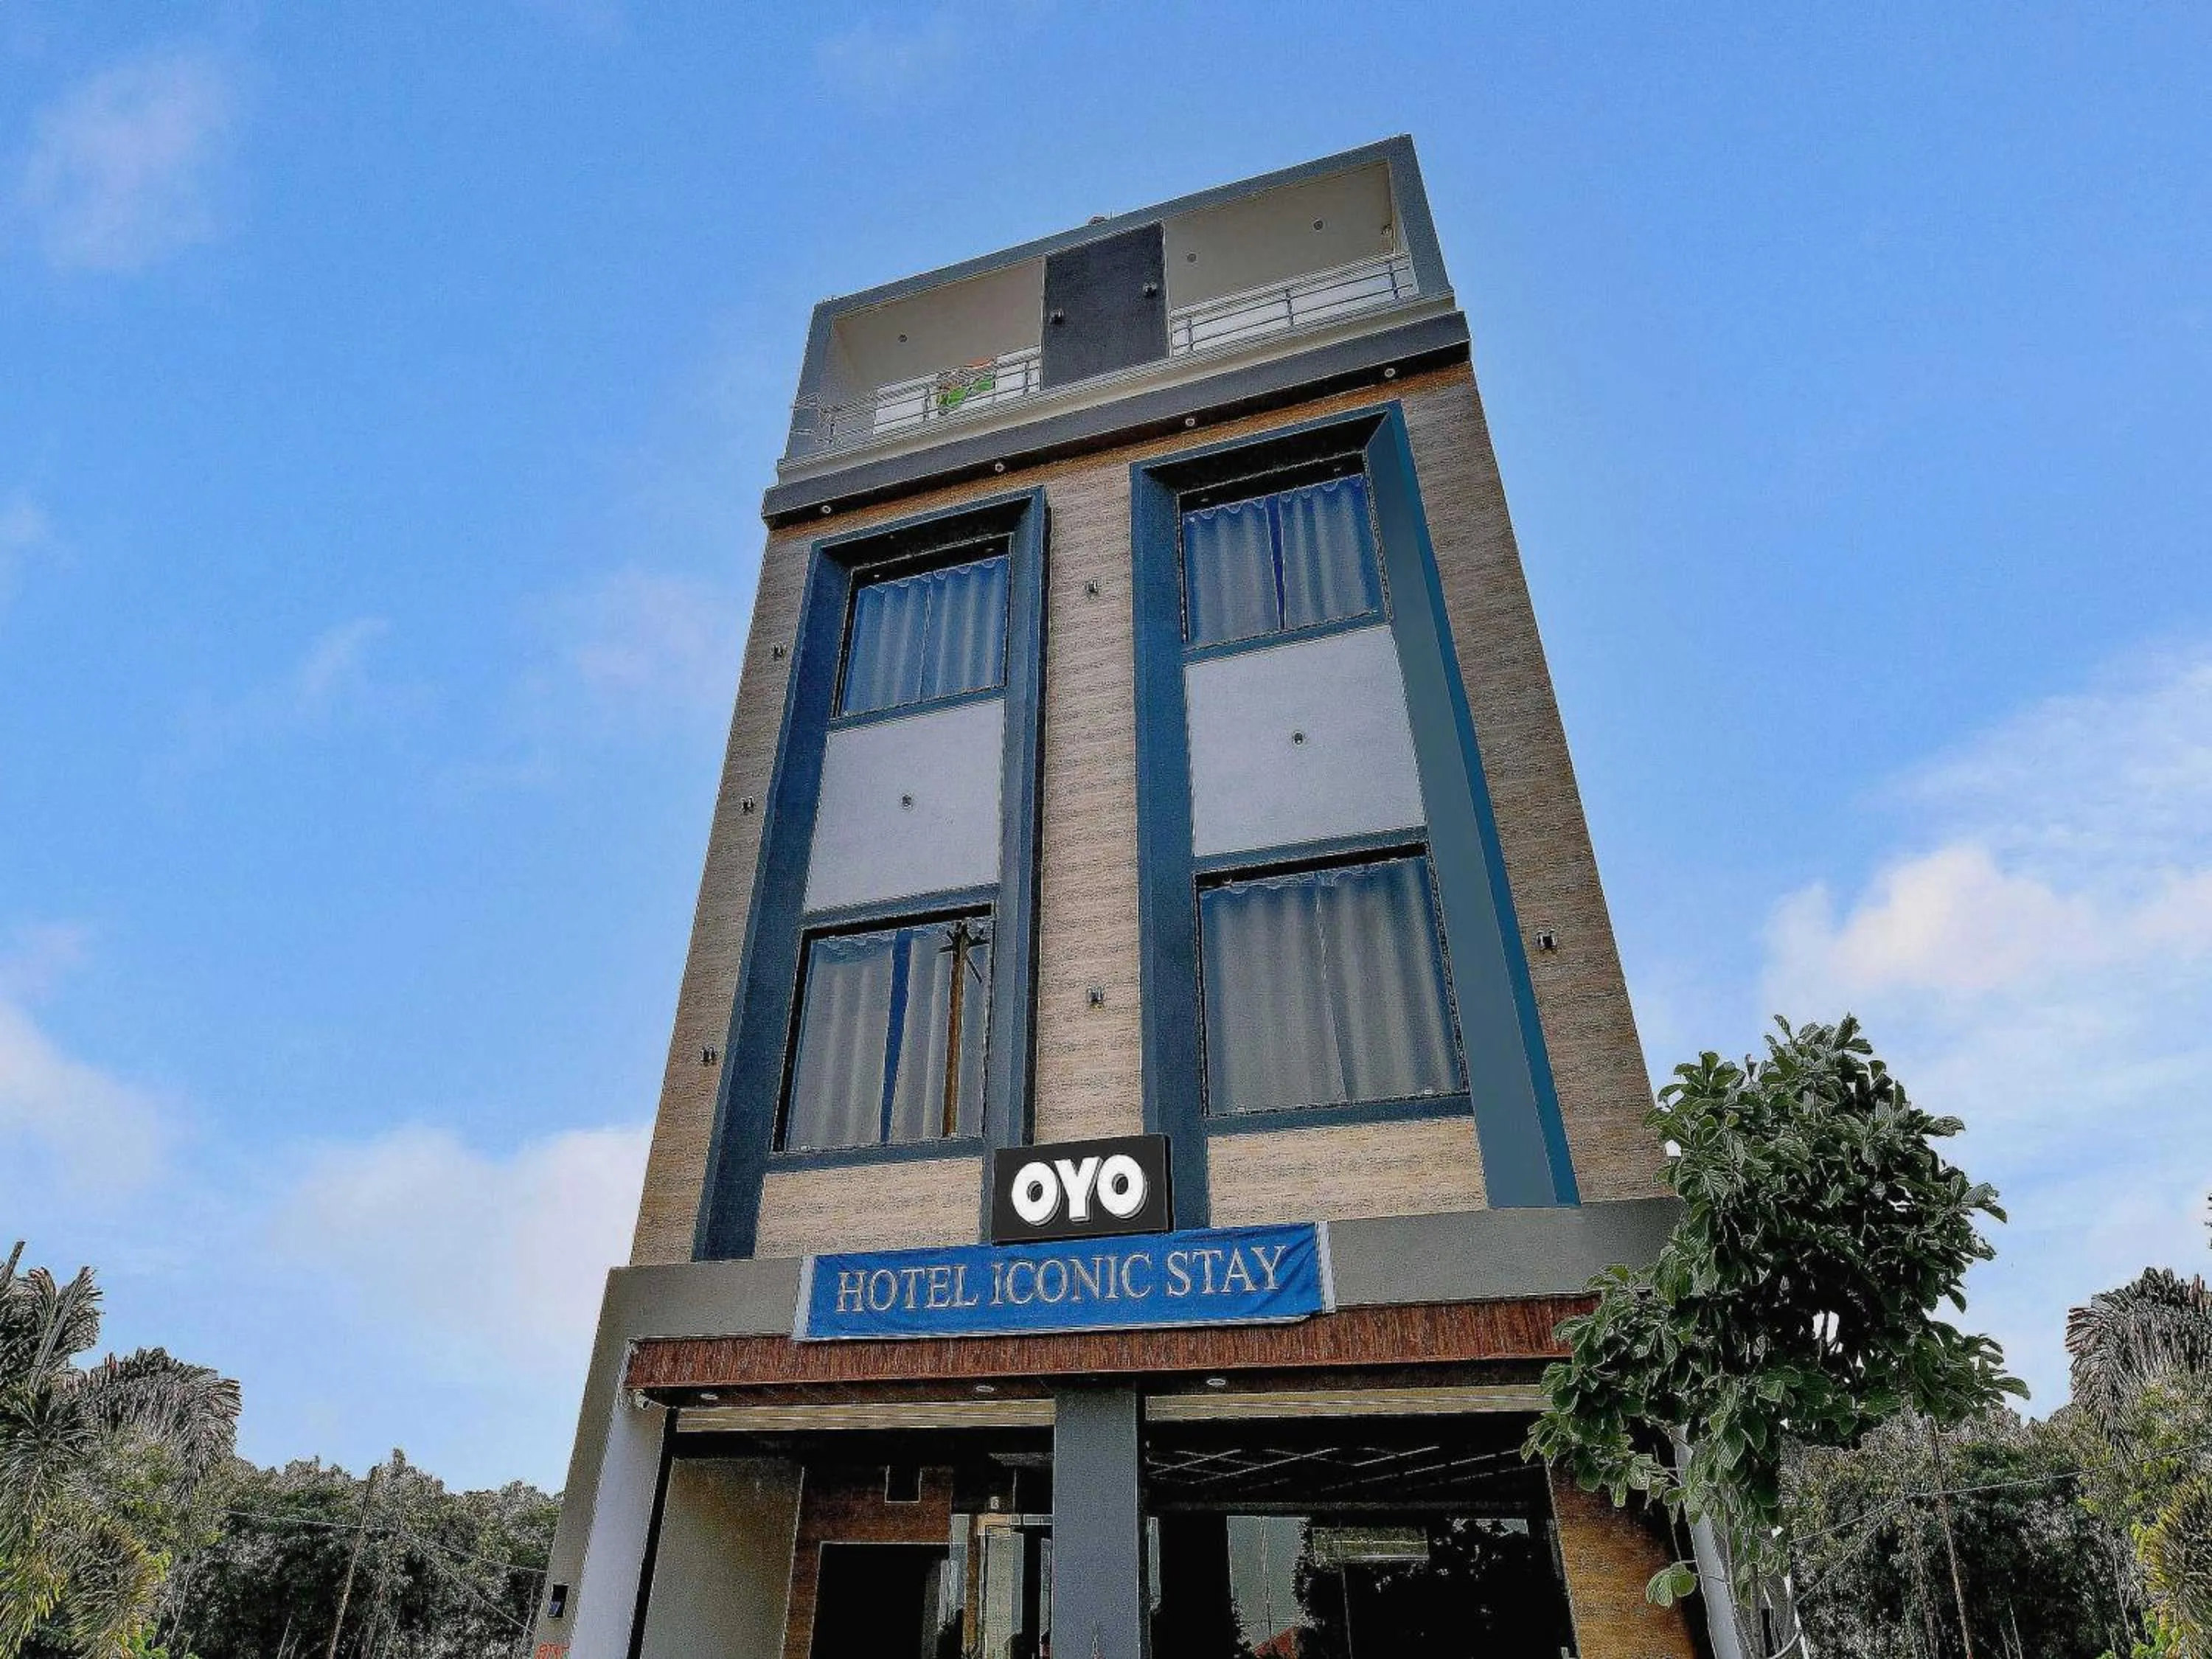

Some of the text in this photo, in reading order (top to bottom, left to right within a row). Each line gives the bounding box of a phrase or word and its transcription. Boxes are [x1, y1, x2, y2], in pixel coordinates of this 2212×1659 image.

[1011, 1153, 1148, 1226] OYO
[835, 1245, 1286, 1313] HOTEL ICONIC STAY
